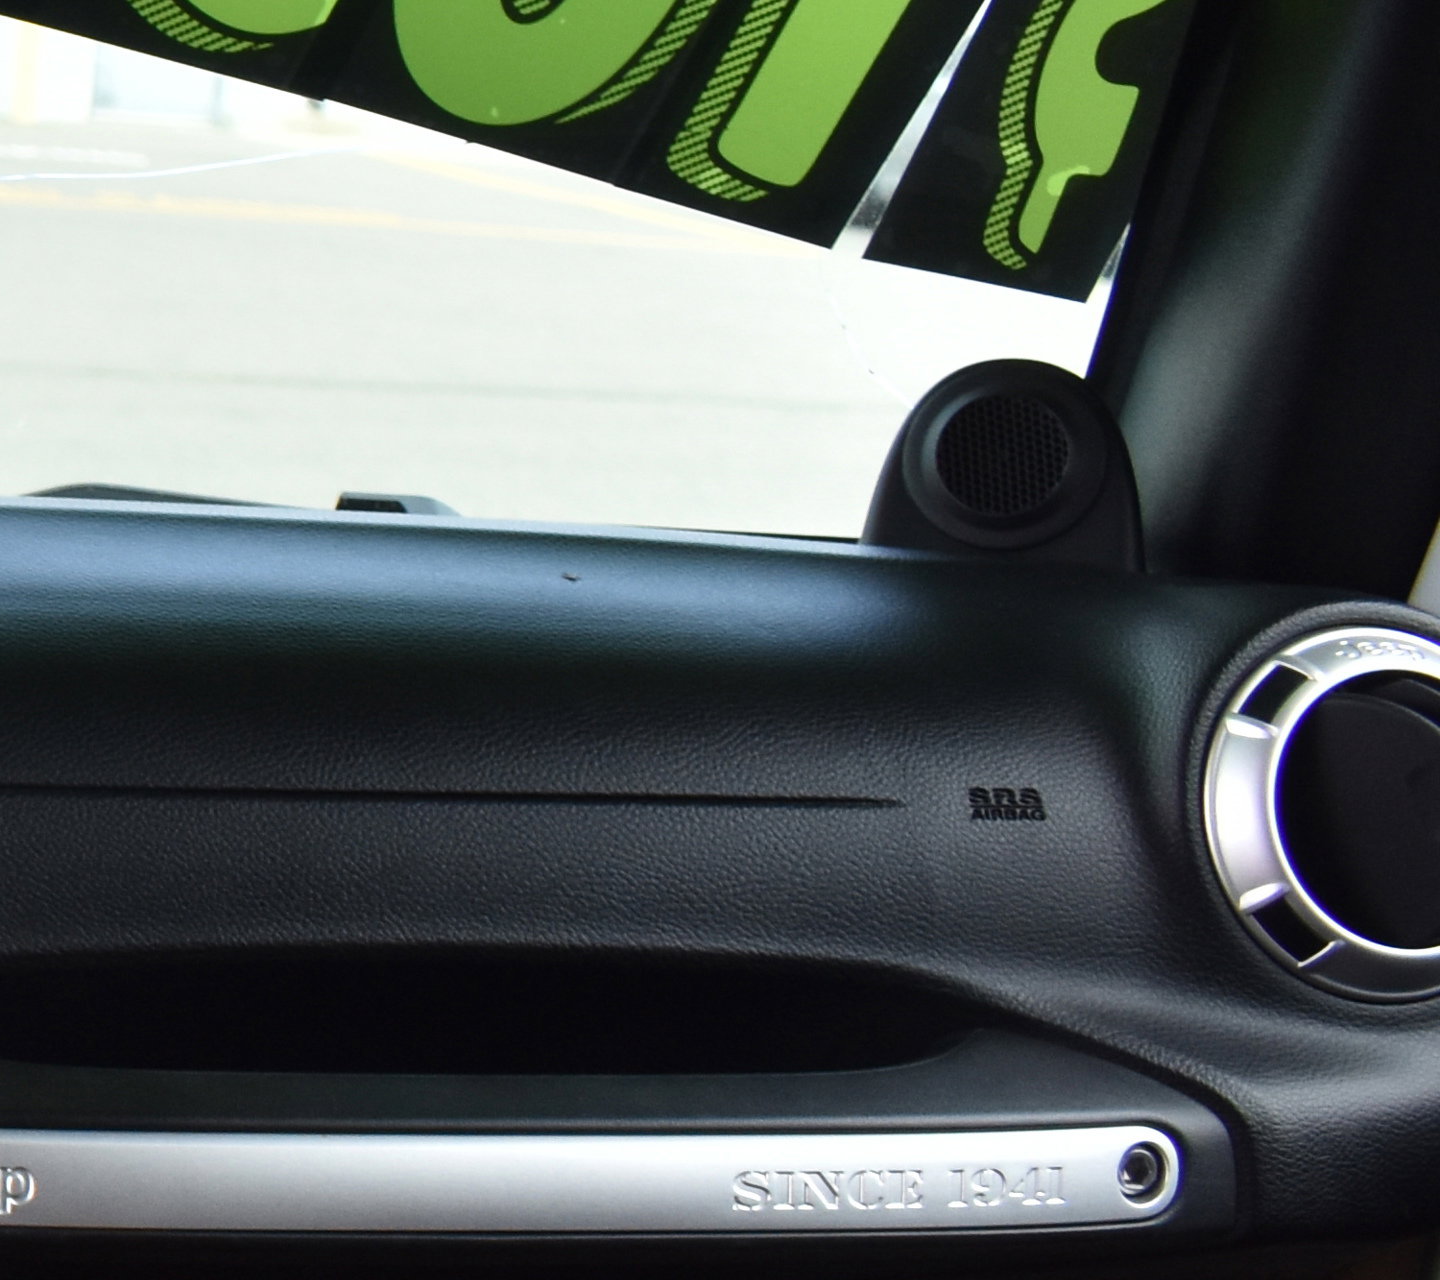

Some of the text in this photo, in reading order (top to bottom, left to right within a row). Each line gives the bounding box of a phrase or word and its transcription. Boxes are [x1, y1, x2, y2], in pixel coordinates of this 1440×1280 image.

[968, 787, 1043, 806] SRS
[970, 805, 1047, 822] AIRBAG
[732, 1166, 1066, 1212] SINCE 1941
